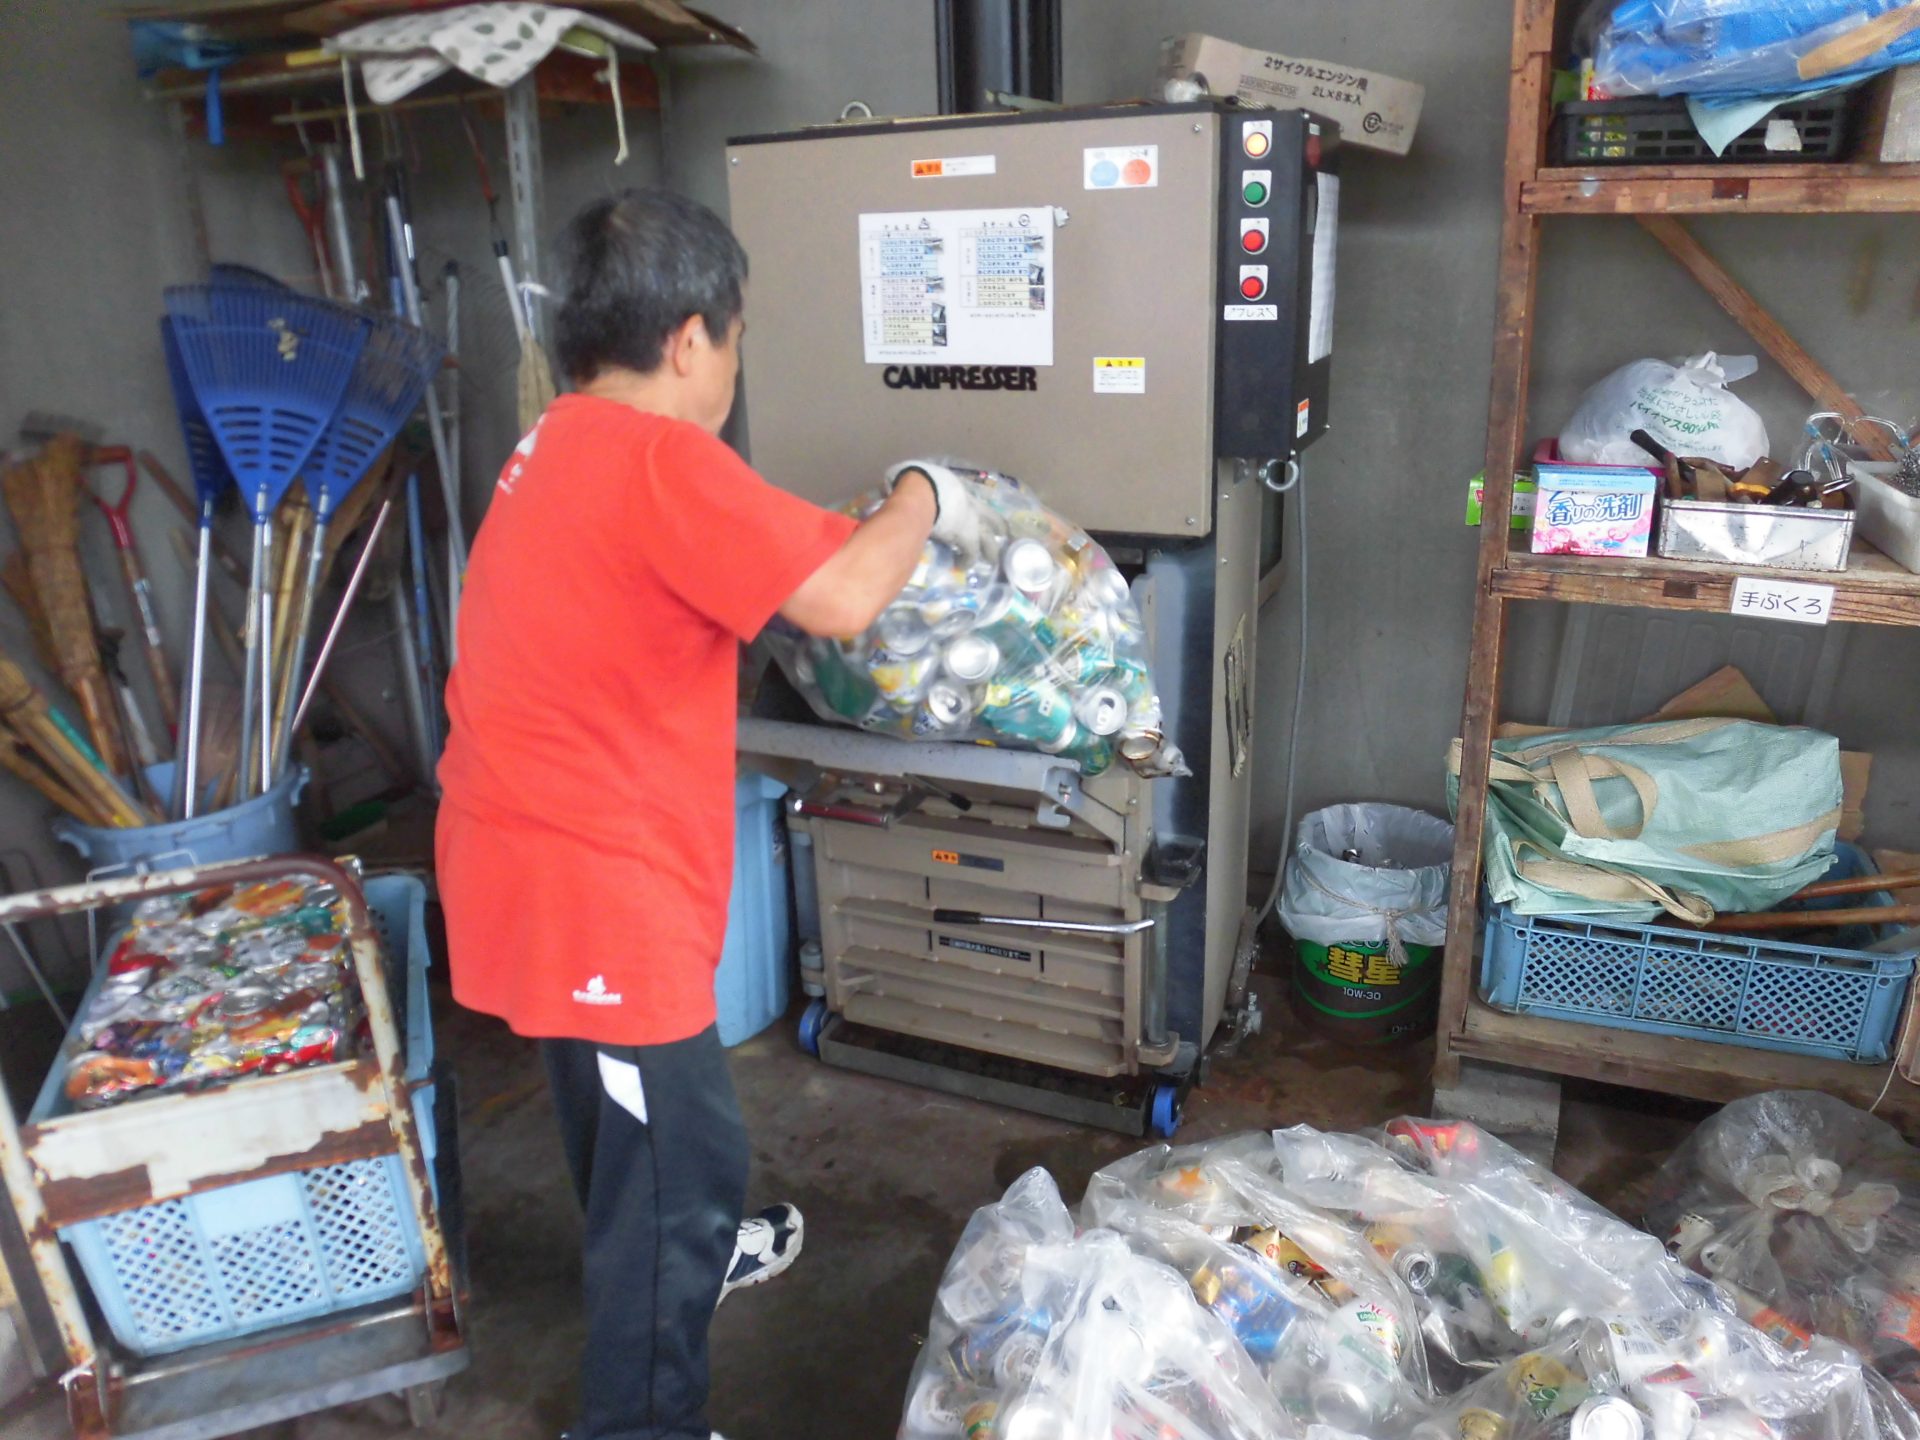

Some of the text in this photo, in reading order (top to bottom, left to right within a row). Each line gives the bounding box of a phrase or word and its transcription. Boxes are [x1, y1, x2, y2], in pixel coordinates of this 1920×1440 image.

[1263, 56, 1369, 92] 2サイクルエンジン用
[883, 364, 1037, 391] CANPRESSER
[1547, 494, 1643, 525] 香りの洗剤
[1740, 591, 1822, 615] 手ぶくろ
[1343, 986, 1382, 1001] 10W-30
